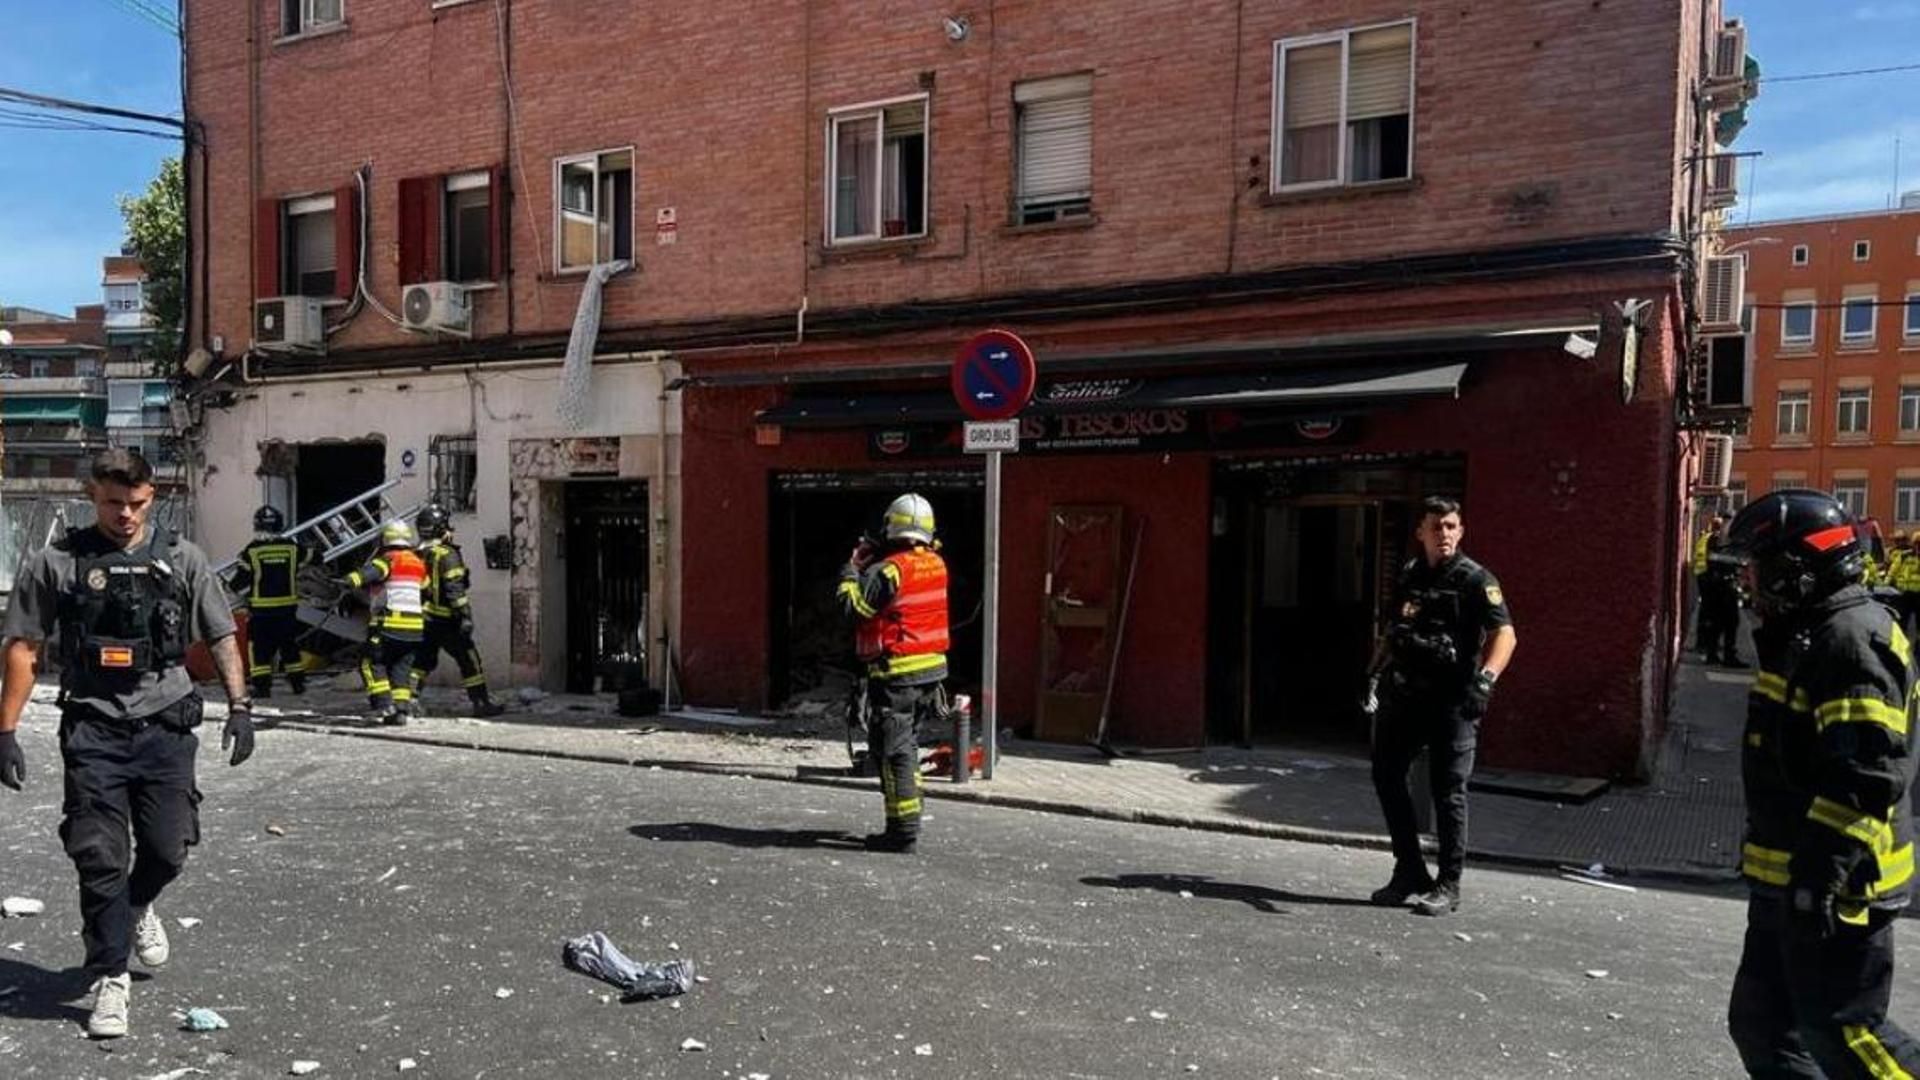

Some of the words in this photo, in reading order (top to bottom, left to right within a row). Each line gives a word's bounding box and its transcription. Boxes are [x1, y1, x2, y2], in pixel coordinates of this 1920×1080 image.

[1055, 409, 1188, 437] TESOROS
[970, 428, 992, 442] GIRO
[993, 428, 1012, 442] BUS
